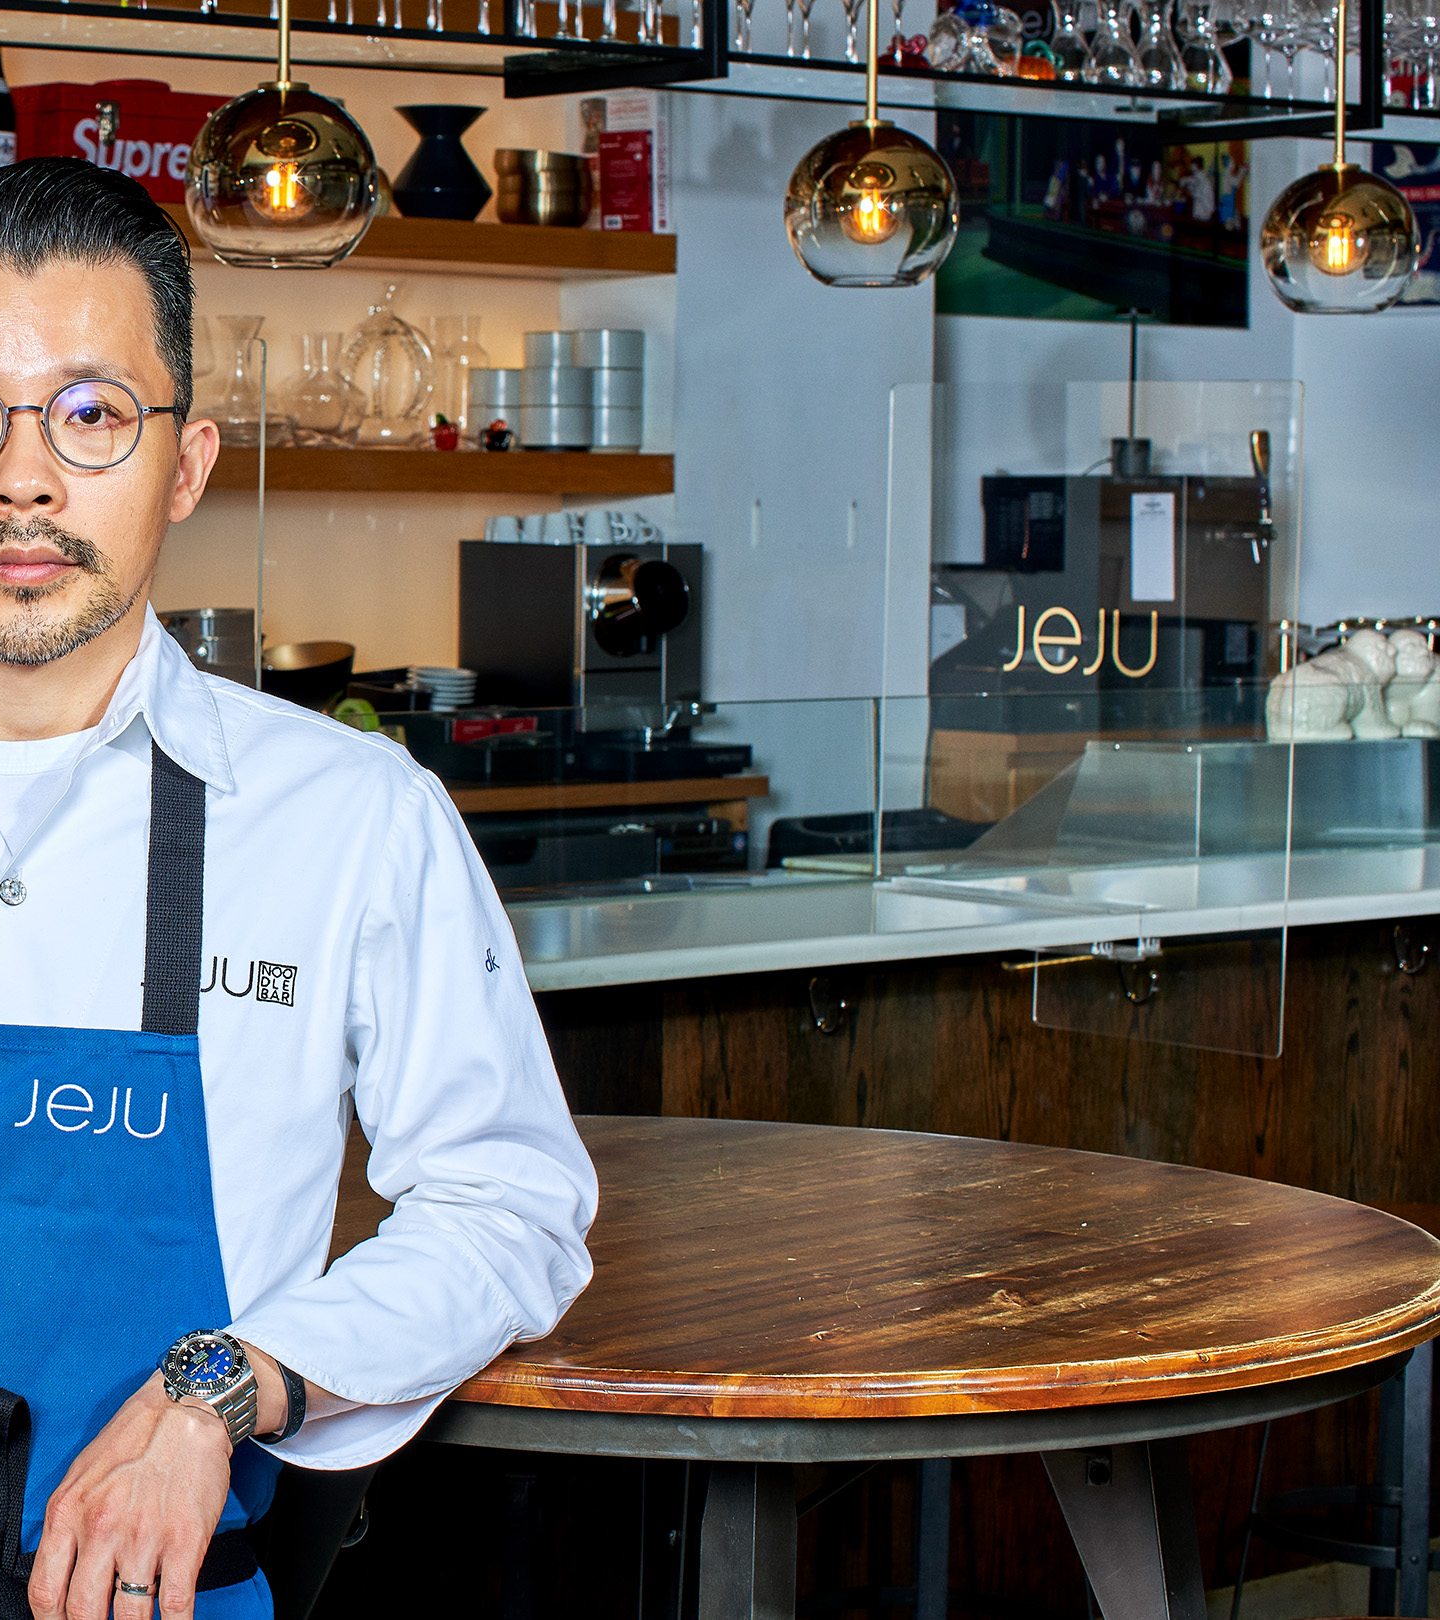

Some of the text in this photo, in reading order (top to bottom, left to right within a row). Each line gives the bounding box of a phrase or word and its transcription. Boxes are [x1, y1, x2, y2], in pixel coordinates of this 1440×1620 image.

[73, 118, 192, 181] Supre
[200, 956, 255, 998] JU
[261, 965, 293, 979] NOO
[261, 976, 290, 991] DLE
[261, 988, 290, 1003] BAR
